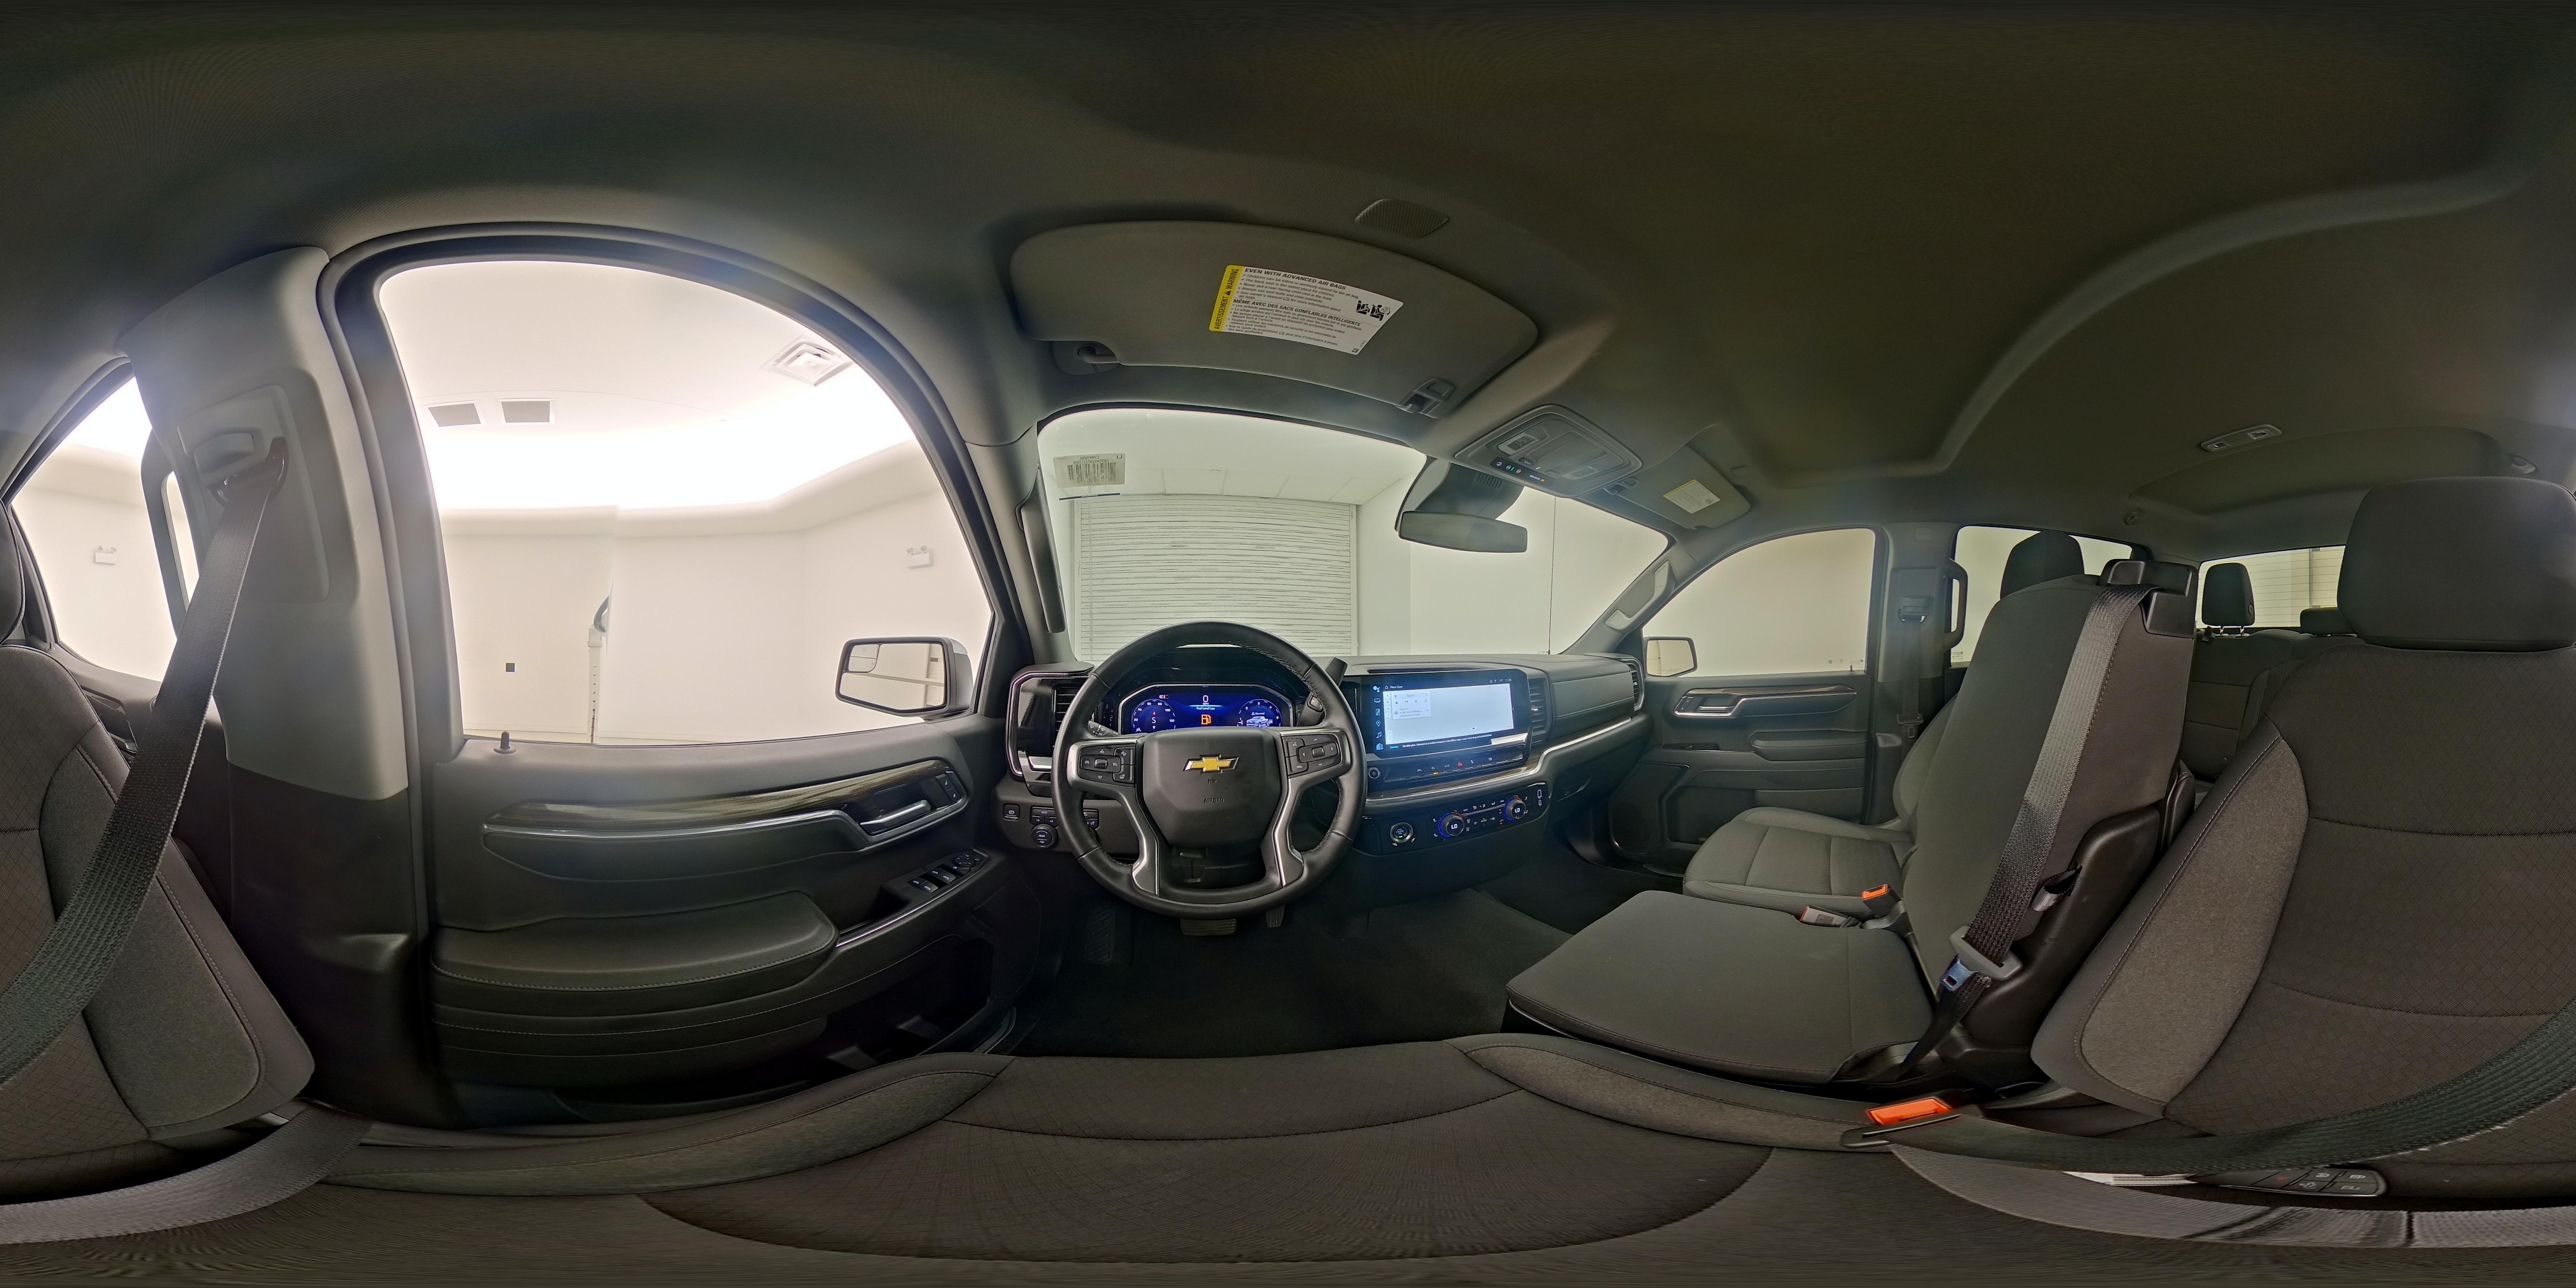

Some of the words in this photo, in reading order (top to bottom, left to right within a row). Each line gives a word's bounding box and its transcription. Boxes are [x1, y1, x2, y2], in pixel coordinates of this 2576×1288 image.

[1226, 268, 1239, 289] WARNING
[1282, 274, 1317, 283] ADVANCED
[1214, 296, 1229, 329] AVERTISSEMENT
[1295, 308, 1328, 318] GONFLABLES
[1328, 315, 1361, 327] INTELLIGENTS
